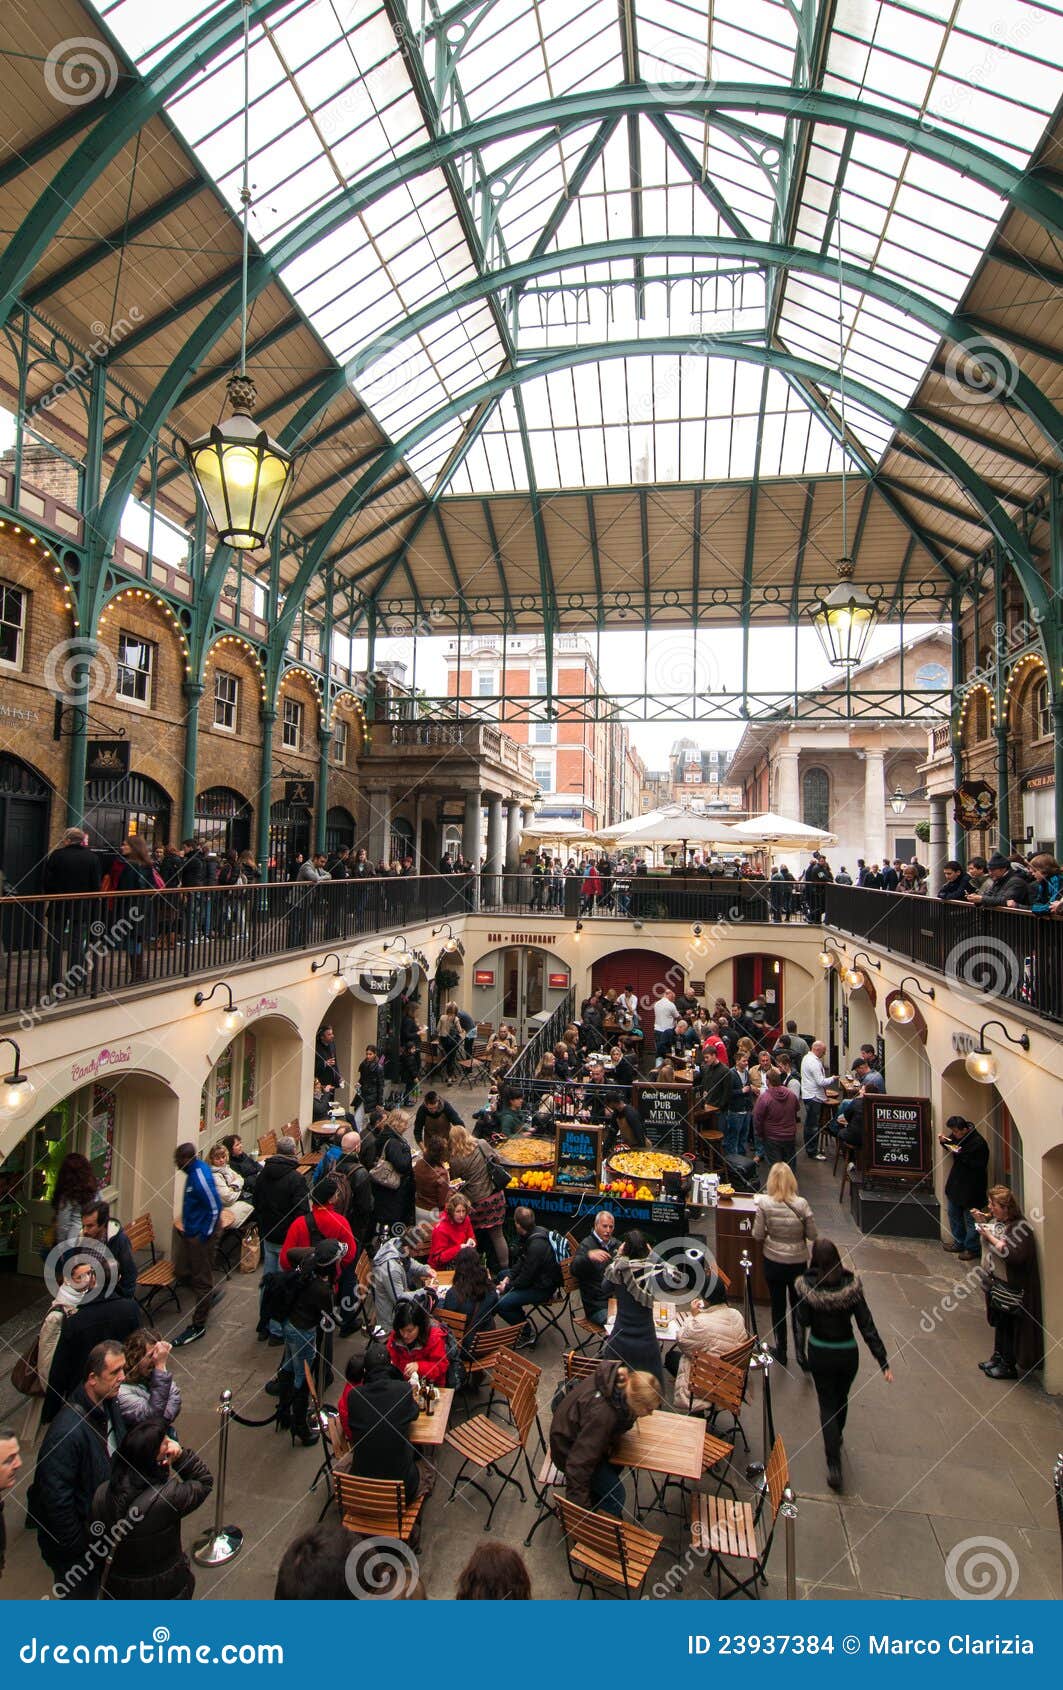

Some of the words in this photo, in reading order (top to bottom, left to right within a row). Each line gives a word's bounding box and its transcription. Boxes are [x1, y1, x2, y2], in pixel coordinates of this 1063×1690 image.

[487, 933, 502, 942] BAR
[511, 934, 557, 944] RESTAURANT
[370, 980, 391, 991] Exit
[654, 1100, 671, 1110] PUB
[650, 1110, 676, 1120] MENU
[876, 1108, 892, 1119] PIE
[892, 1109, 917, 1121] SHOP
